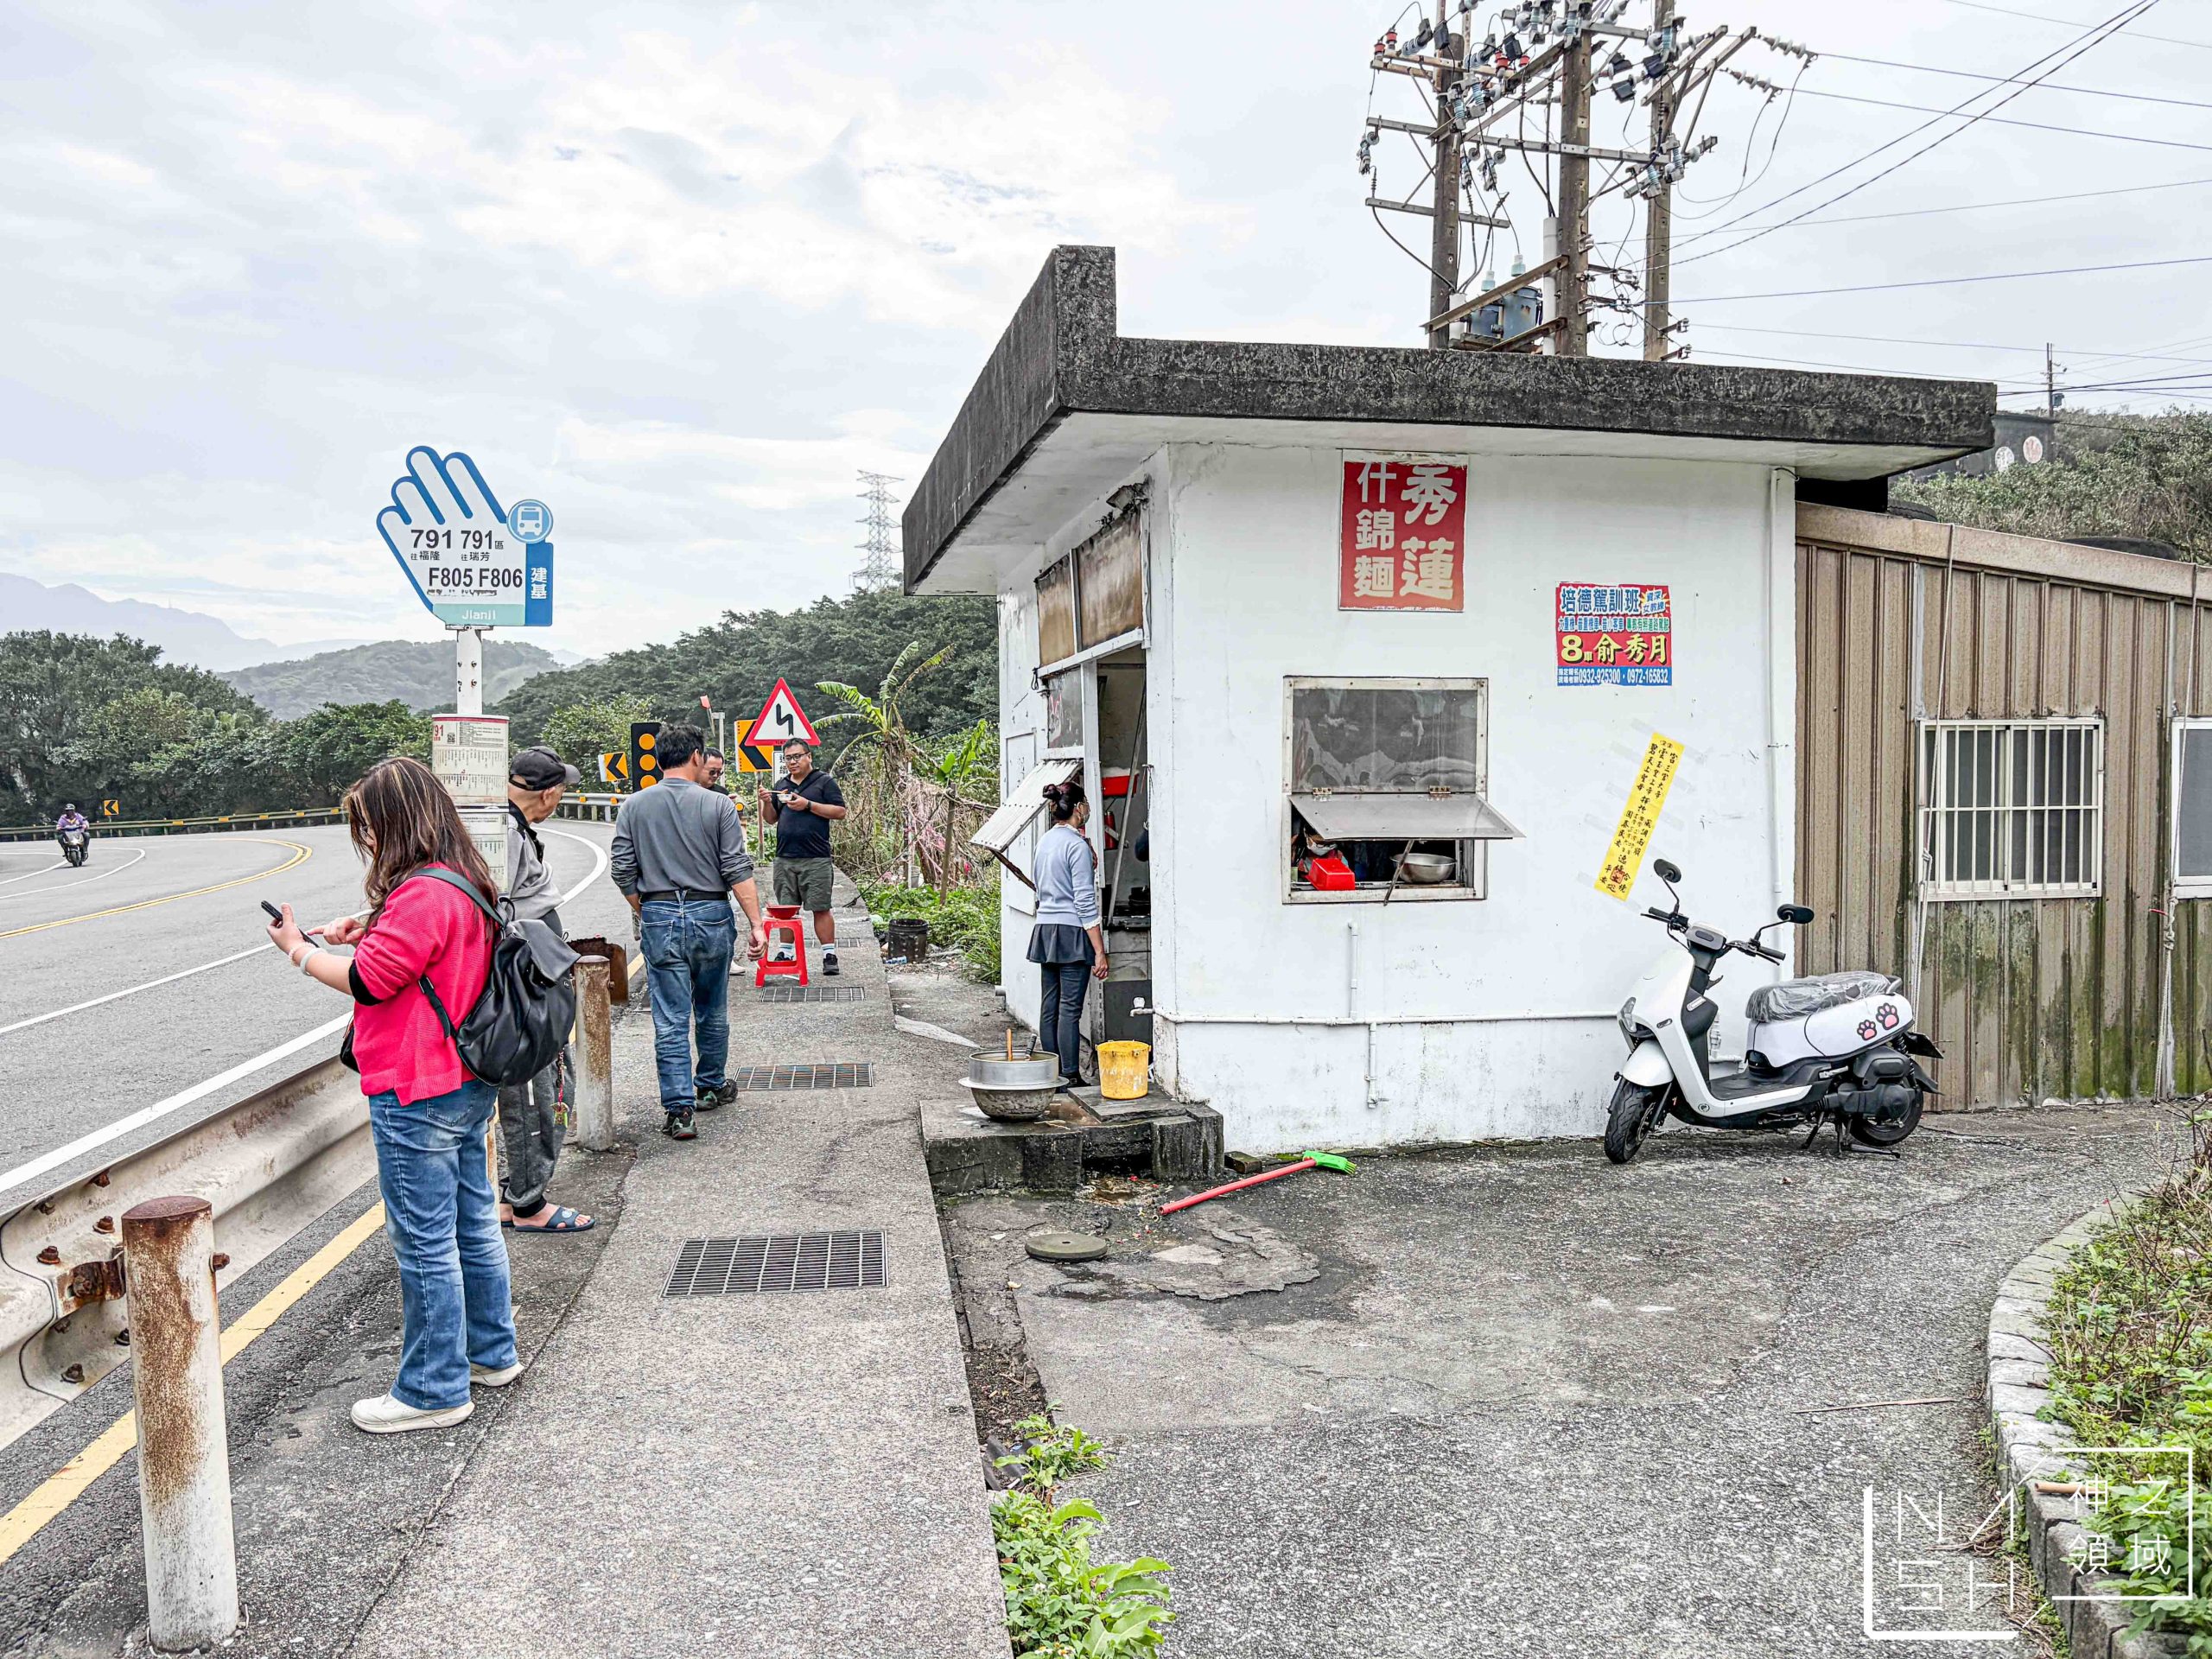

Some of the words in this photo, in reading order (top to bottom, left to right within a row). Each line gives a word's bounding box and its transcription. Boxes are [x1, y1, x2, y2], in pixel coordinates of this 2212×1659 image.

[410, 529, 452, 550] 791
[1353, 461, 1397, 598] 什錦麵
[1399, 465, 1458, 601] 秀蓮
[410, 550, 440, 561] 往福隆
[461, 552, 490, 562] 往瑞芳
[429, 567, 473, 588] F805
[479, 568, 523, 588] F806
[530, 567, 548, 600] 建基
[1561, 588, 1639, 613] 培德駕訓班
